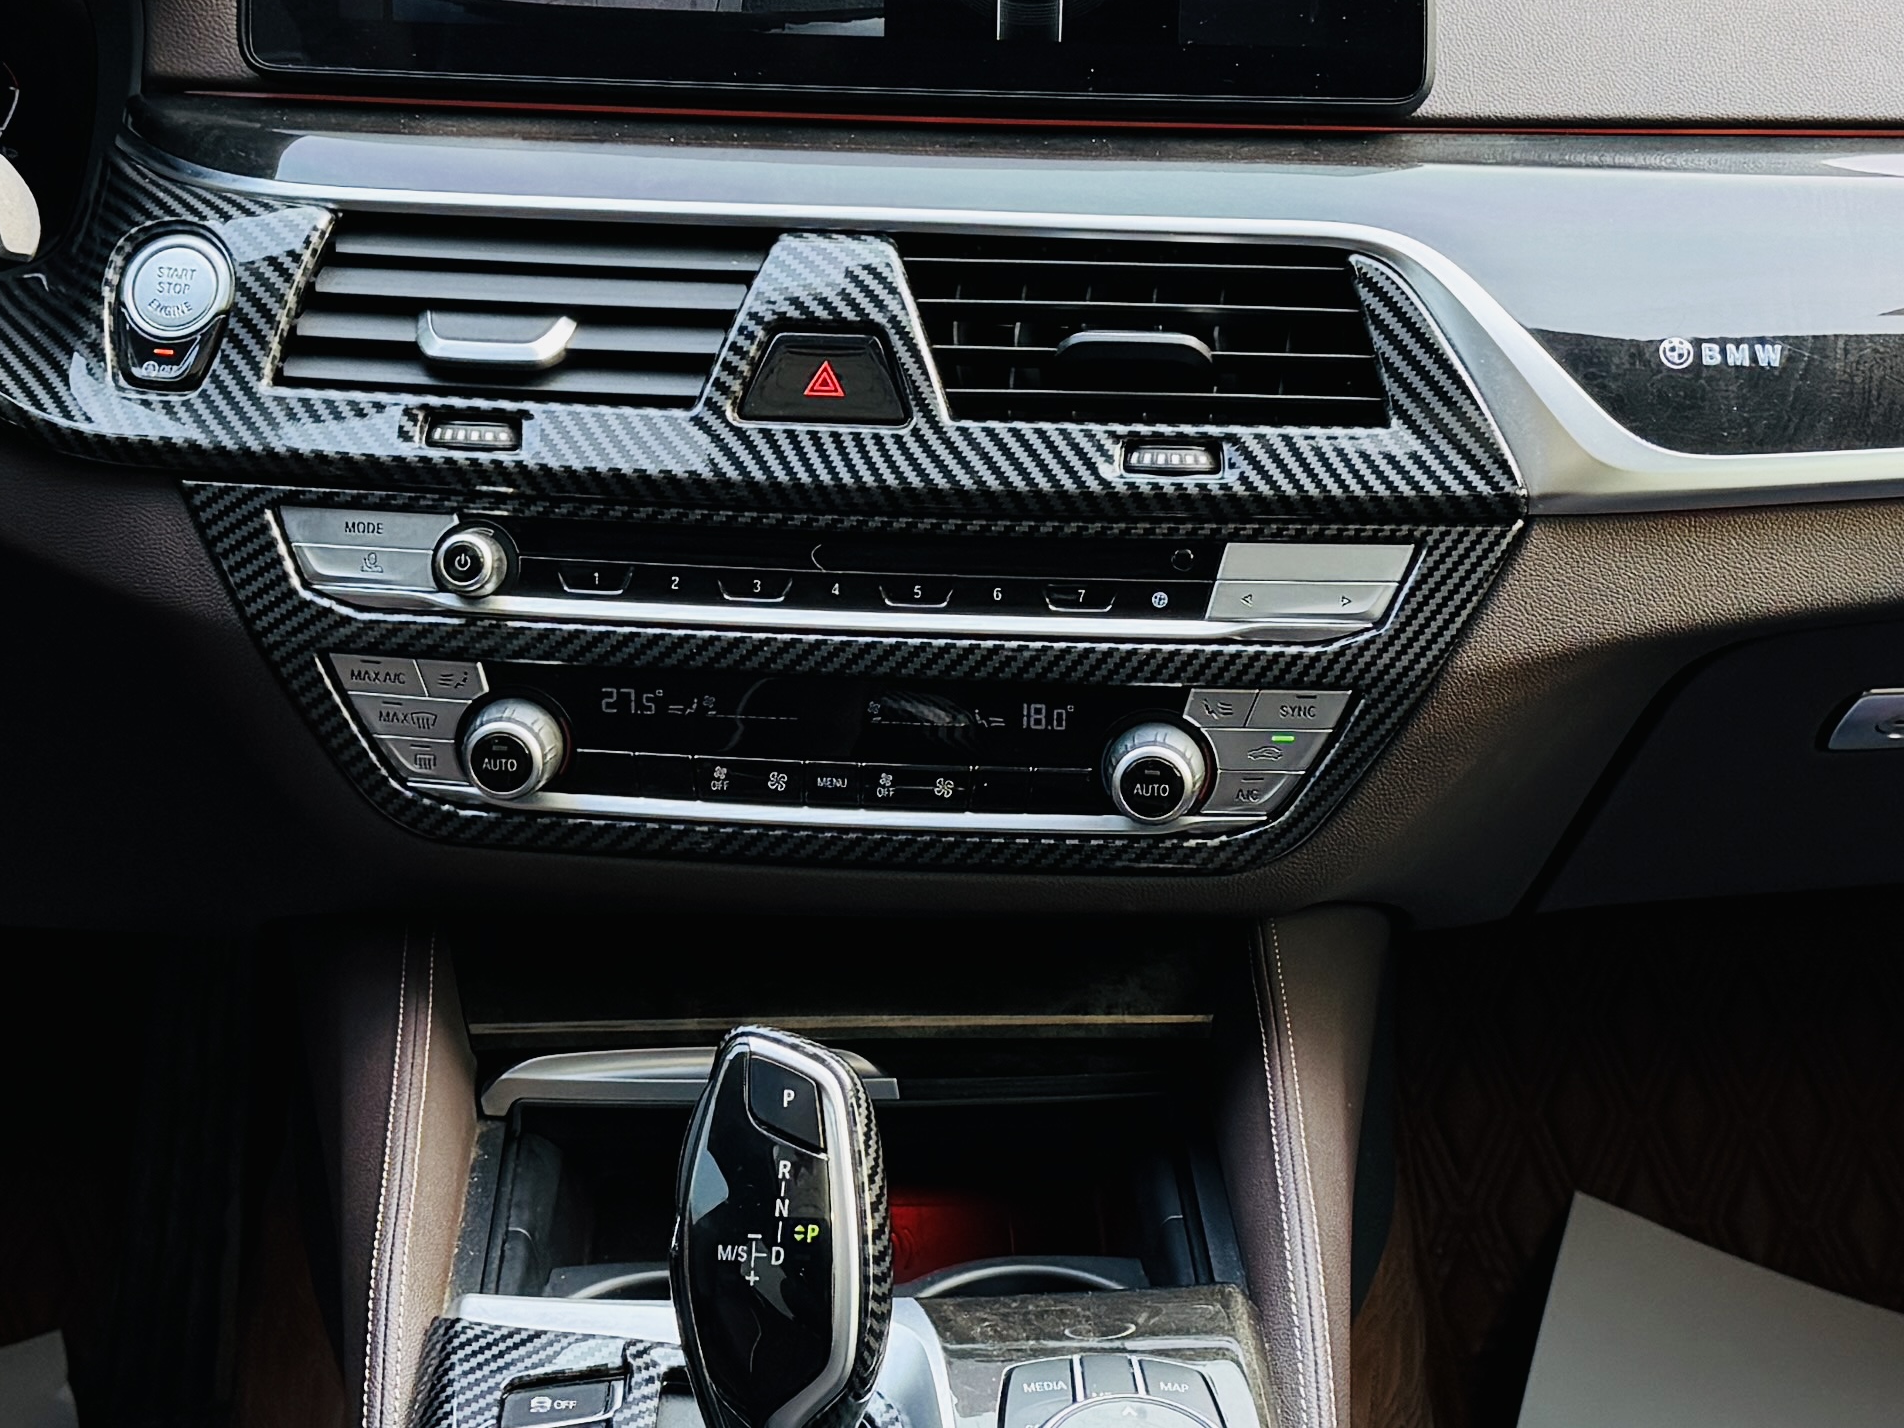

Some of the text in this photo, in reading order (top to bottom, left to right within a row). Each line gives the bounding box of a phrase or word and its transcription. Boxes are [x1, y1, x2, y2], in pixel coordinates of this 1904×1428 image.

[157, 266, 197, 281] START
[156, 281, 191, 295] STOP
[147, 298, 193, 317] ENGINE
[1701, 343, 1782, 367] BMW
[344, 521, 385, 536] MODE
[670, 576, 680, 589] 2
[752, 580, 762, 593] 3
[831, 583, 841, 597] 4
[913, 585, 922, 599] 5
[993, 588, 1002, 601] 6
[1077, 590, 1086, 603] 7
[350, 669, 382, 683] MAX
[378, 710, 410, 724] MAX
[1279, 704, 1317, 720] SYNC
[482, 757, 518, 772] AUTO
[710, 780, 729, 791] OFF
[817, 776, 848, 789] MENU
[876, 787, 895, 798] OFF
[1134, 782, 1170, 798] AUTO
[783, 1089, 795, 1107] P
[777, 1160, 791, 1179] R
[775, 1198, 790, 1218] N
[806, 1224, 820, 1243] P
[717, 1244, 785, 1265] M/S D
[1023, 1380, 1068, 1394] MEDIA
[1159, 1381, 1189, 1394] MAP
[553, 1400, 577, 1410] OFF
